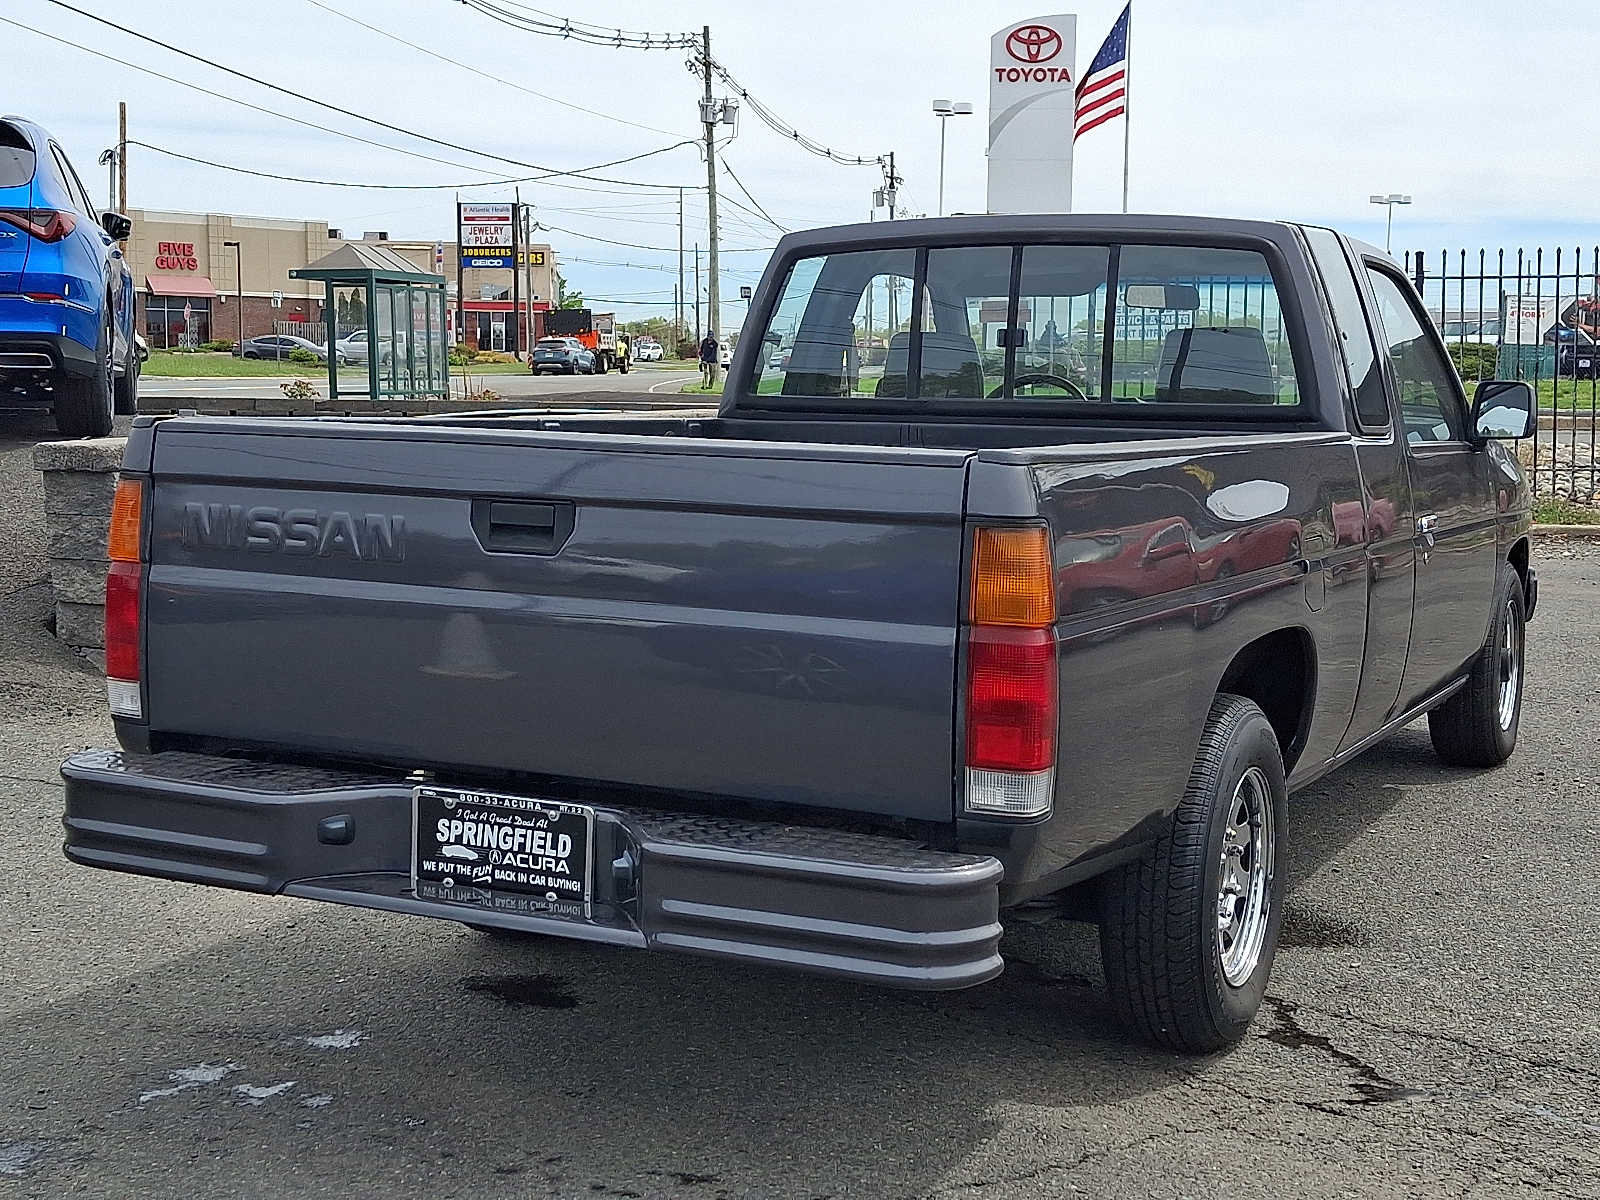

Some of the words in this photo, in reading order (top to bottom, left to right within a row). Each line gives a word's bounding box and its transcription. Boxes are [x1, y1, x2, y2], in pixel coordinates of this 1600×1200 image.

[994, 67, 1071, 83] TOYOTA
[468, 226, 504, 236] JEWELRY
[158, 241, 194, 256] FIVE
[474, 236, 500, 245] PLAZA
[155, 256, 198, 271] GUYS
[183, 501, 406, 561] NISSAN
[459, 793, 542, 811] 800-33-ACURA
[463, 809, 478, 821] Got
[479, 811, 488, 821] A
[488, 812, 513, 825] Great
[513, 815, 536, 827] Deal
[436, 818, 572, 858] SPRINGFIELD
[502, 852, 571, 875] ACURA
[422, 860, 437, 872] WE
[438, 862, 456, 873] PUT
[456, 864, 472, 876] THE
[472, 863, 493, 878] FUN
[494, 869, 517, 881] BACK
[517, 872, 527, 883] IN
[529, 873, 546, 886] CAR
[547, 876, 581, 892] BUYING!
